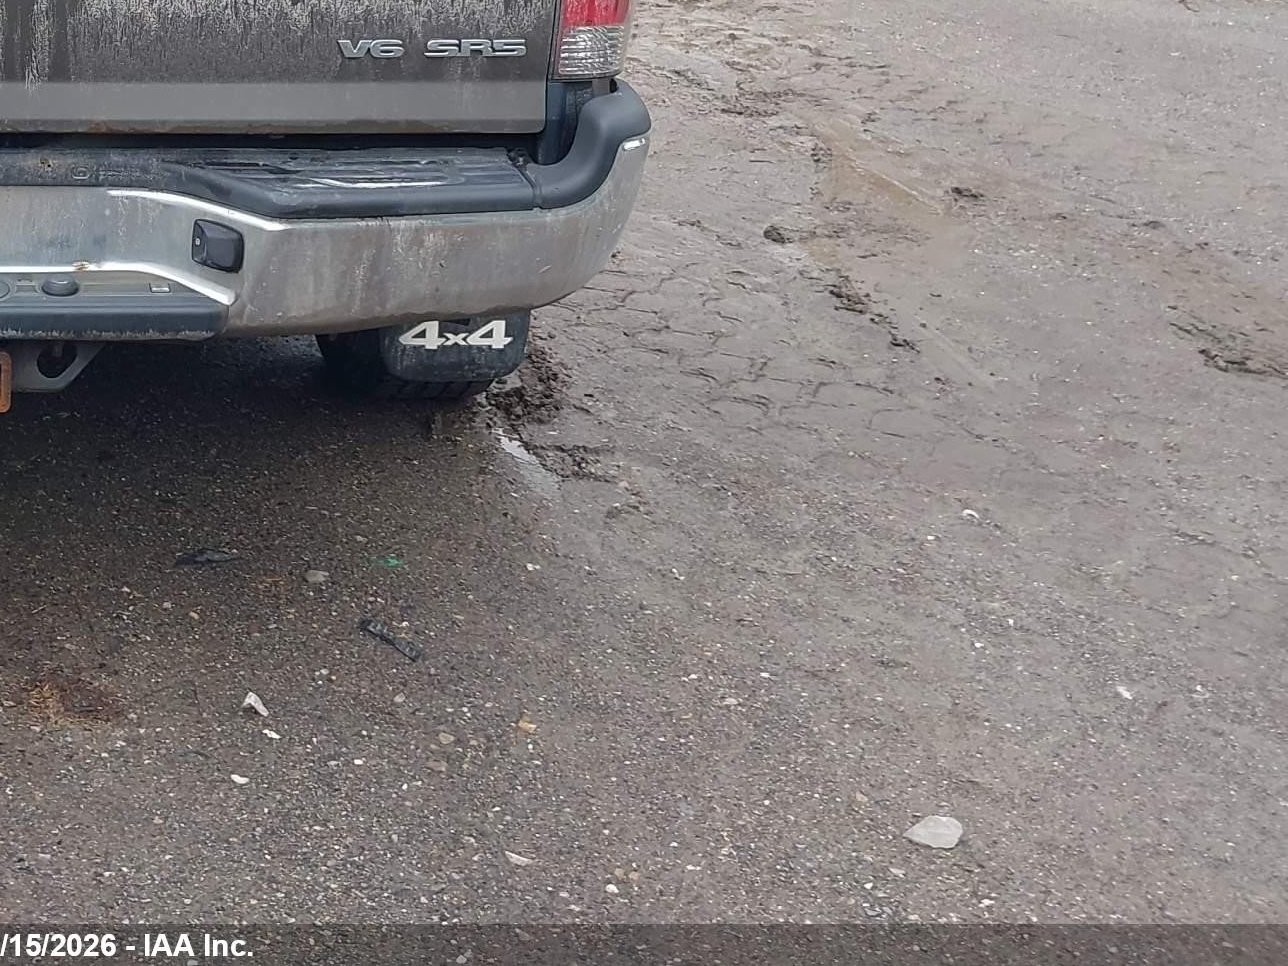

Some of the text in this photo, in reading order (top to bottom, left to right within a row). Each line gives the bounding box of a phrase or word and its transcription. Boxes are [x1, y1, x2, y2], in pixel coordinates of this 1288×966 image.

[338, 39, 527, 58] V6 SR5
[398, 319, 513, 350] 4x4
